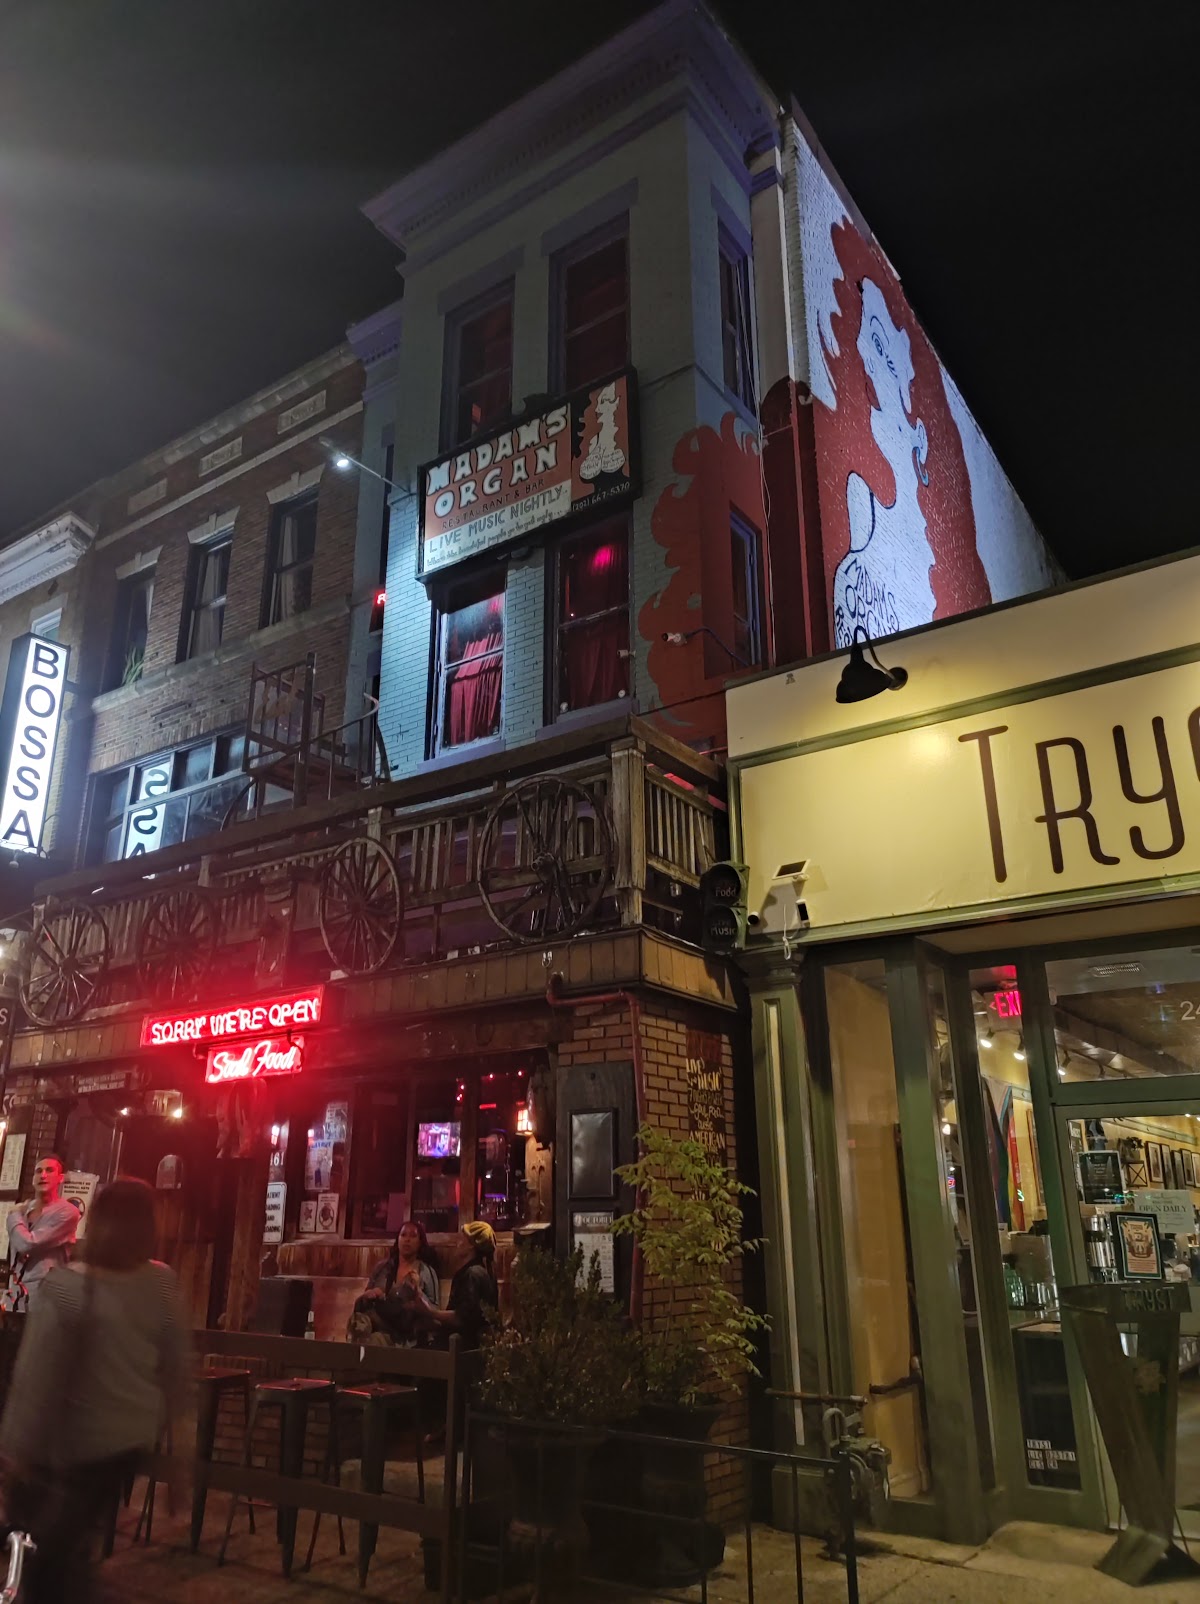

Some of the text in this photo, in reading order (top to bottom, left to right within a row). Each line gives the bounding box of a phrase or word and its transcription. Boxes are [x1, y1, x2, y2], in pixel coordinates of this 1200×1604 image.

[427, 404, 569, 496] MADAM'S
[434, 441, 558, 518] ORGAN
[442, 479, 544, 530] RESTAURANT & BAR
[429, 528, 462, 553] LIVE
[468, 509, 506, 537] MUSIC
[3, 642, 60, 849] BOSSA
[210, 1007, 267, 1036] WE'RE
[268, 997, 319, 1026] OPEN
[994, 990, 1021, 1018] EXI
[207, 1040, 295, 1083] Soul Food
[686, 1058, 702, 1074] LIVE
[698, 1071, 722, 1091] MUSIC
[689, 1130, 726, 1149] AMERICAN
[1139, 1205, 1187, 1213] OPEN DAILY
